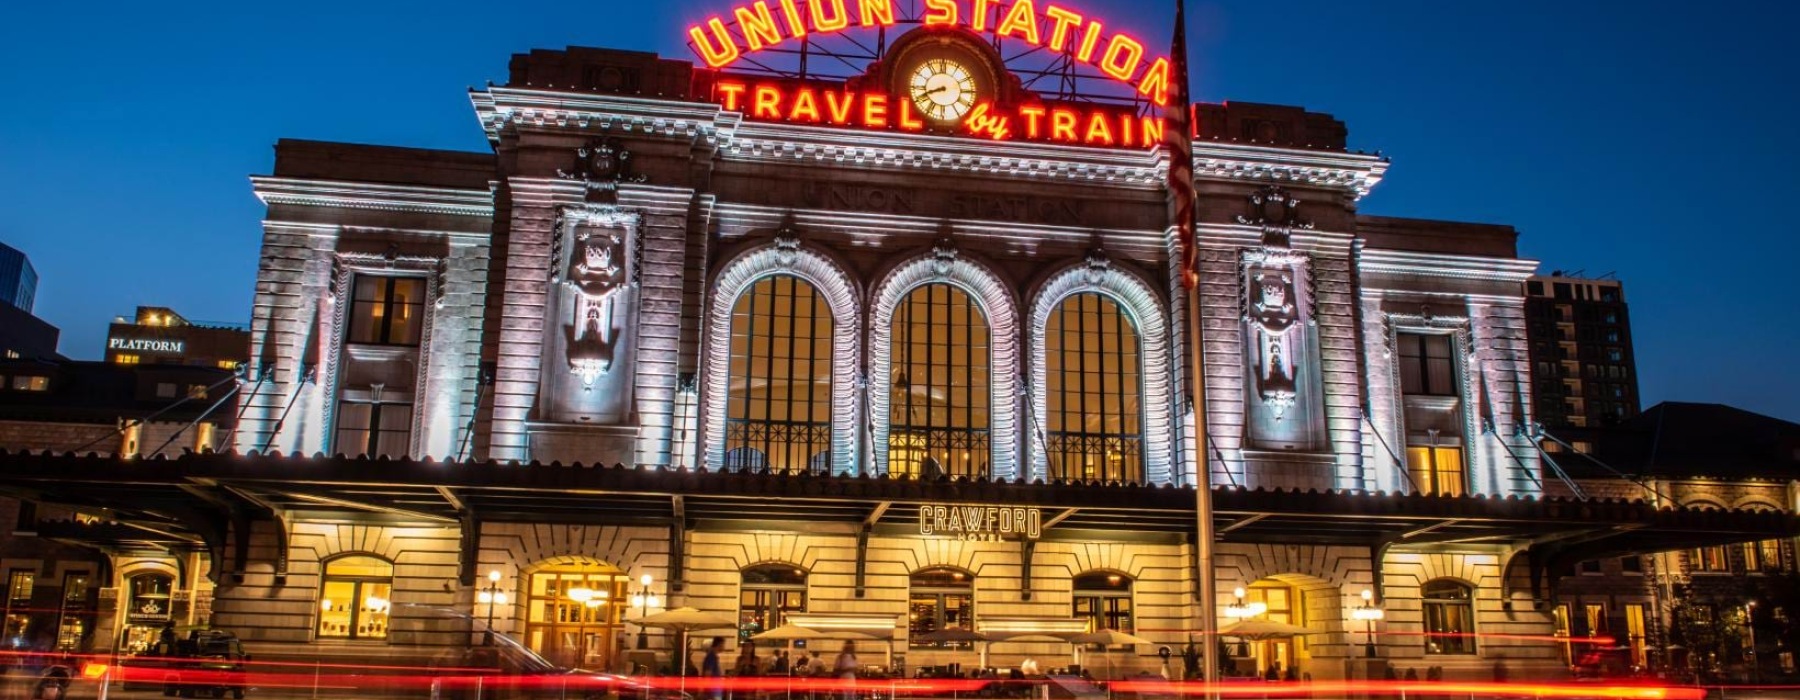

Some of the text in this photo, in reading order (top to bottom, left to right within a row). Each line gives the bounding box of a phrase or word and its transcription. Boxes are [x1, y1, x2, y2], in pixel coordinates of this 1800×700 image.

[689, 0, 895, 68] UNION
[924, 0, 1170, 107] STATION
[718, 82, 923, 129] TRAVEL
[965, 102, 1009, 139] by
[1020, 106, 1164, 146] TRAIN
[804, 183, 914, 213] UNION
[109, 338, 183, 352] PLATFORM
[920, 505, 1041, 539] CRAWFORD
[957, 532, 1005, 543] HOTEL
